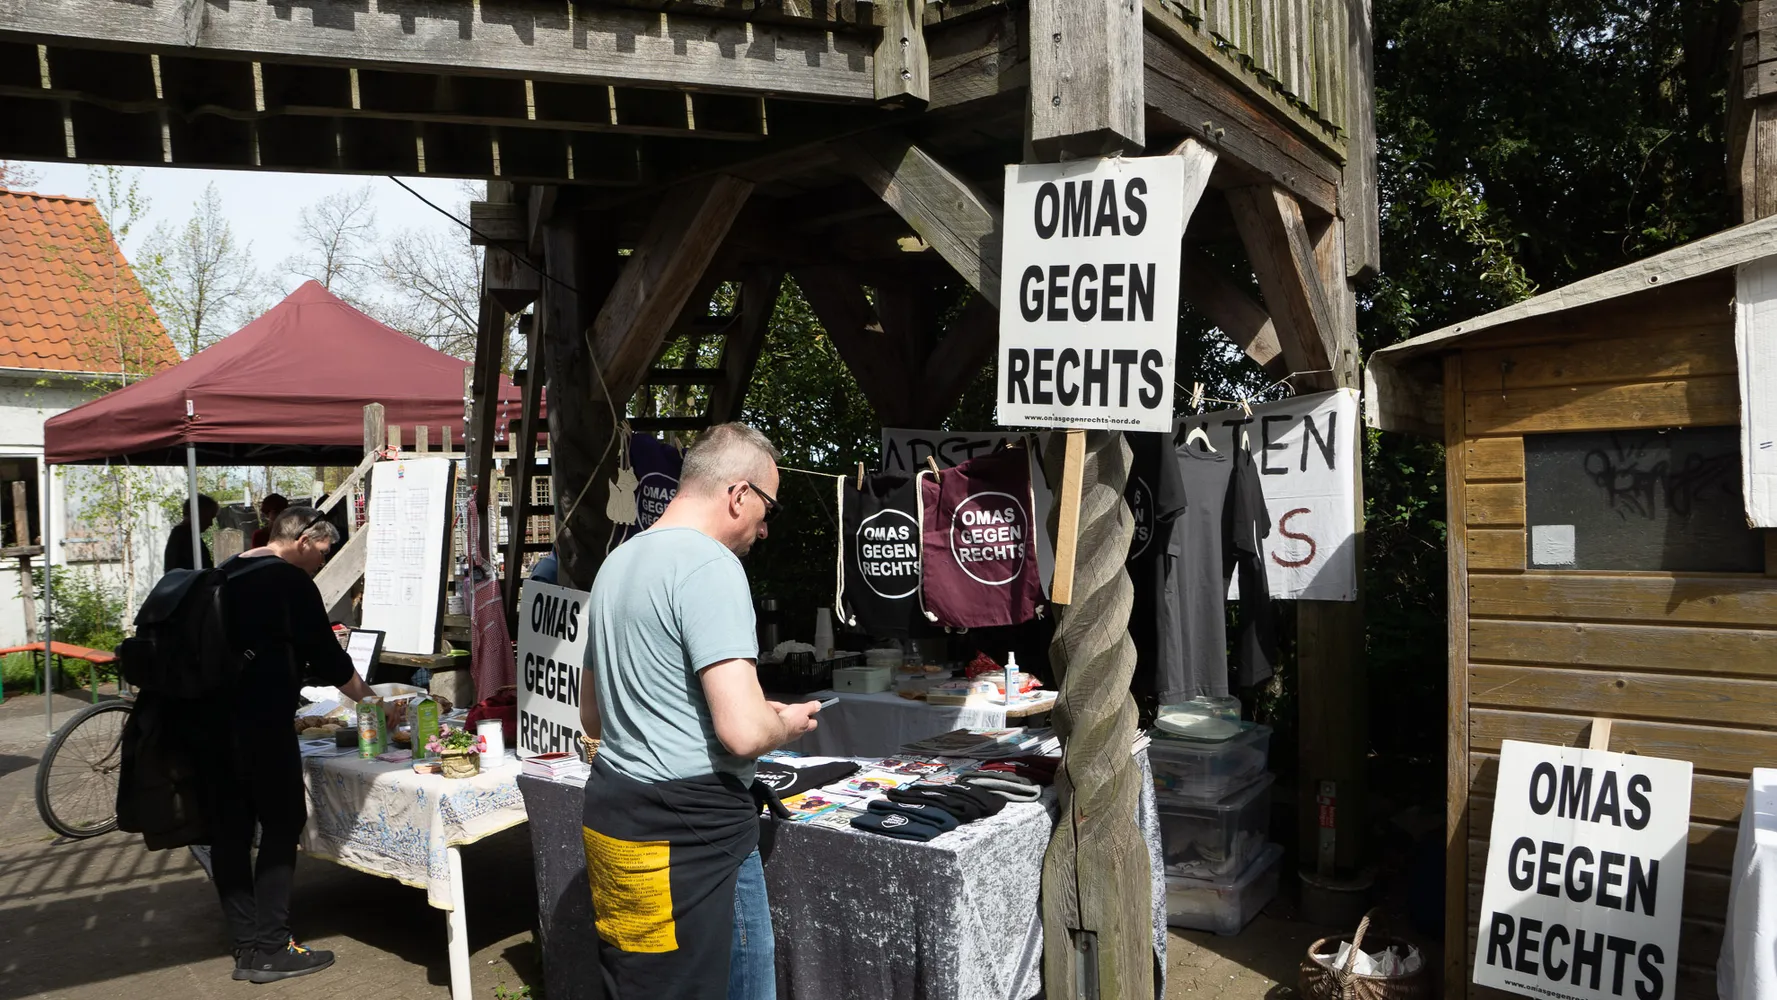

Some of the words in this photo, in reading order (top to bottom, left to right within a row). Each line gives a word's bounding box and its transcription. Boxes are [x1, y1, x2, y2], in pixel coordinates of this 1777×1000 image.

[1034, 177, 1148, 240] OMAS
[1019, 263, 1156, 322] GEGEN
[1007, 347, 1164, 409] RECHTS
[1024, 414, 1141, 425] www.omasgegenrechts-nord.de
[863, 526, 910, 540] OMAS
[960, 526, 1022, 545] GEGEN
[961, 508, 1015, 526] OMAS
[862, 543, 917, 558] GEGEN
[863, 561, 921, 576] RECHTS
[959, 543, 1025, 563] RECHTS
[531, 592, 581, 643] OMAS
[524, 652, 580, 708] GEGEN
[1528, 761, 1652, 831] OMAS
[1508, 836, 1660, 917] GEGEN
[1486, 911, 1665, 1000] RECHTS
